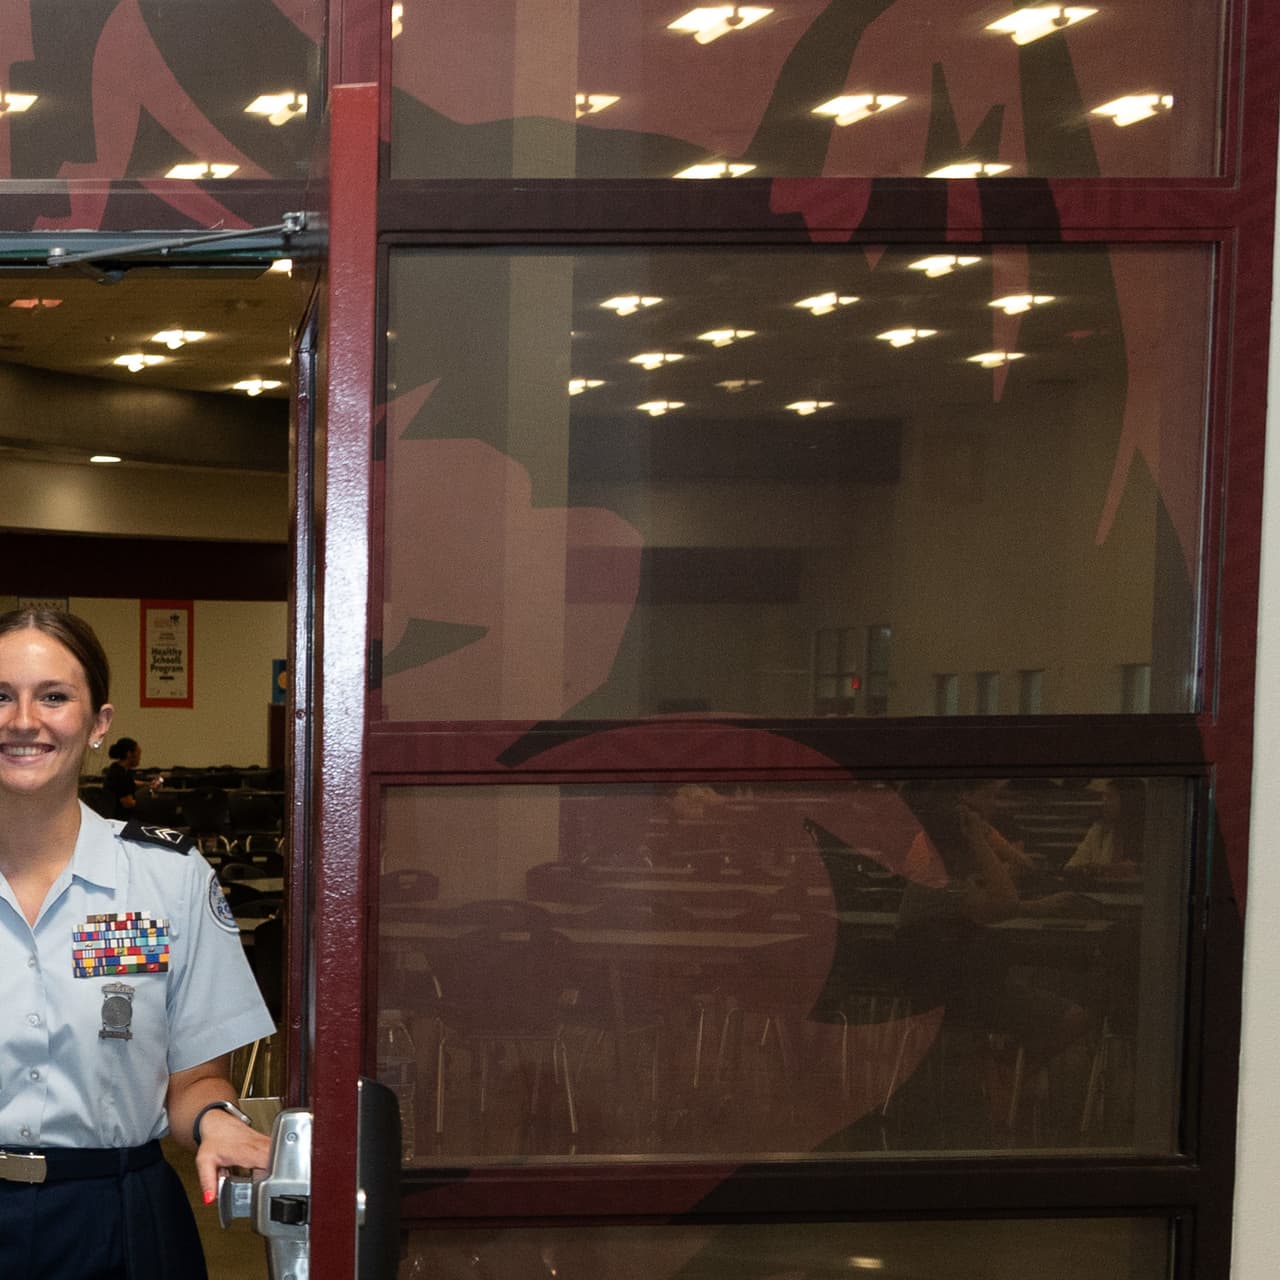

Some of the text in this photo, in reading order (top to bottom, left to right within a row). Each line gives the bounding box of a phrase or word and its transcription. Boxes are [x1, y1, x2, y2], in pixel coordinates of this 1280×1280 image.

[151, 647, 182, 656] Healthy
[152, 656, 181, 664] Schools
[151, 664, 184, 674] Program
